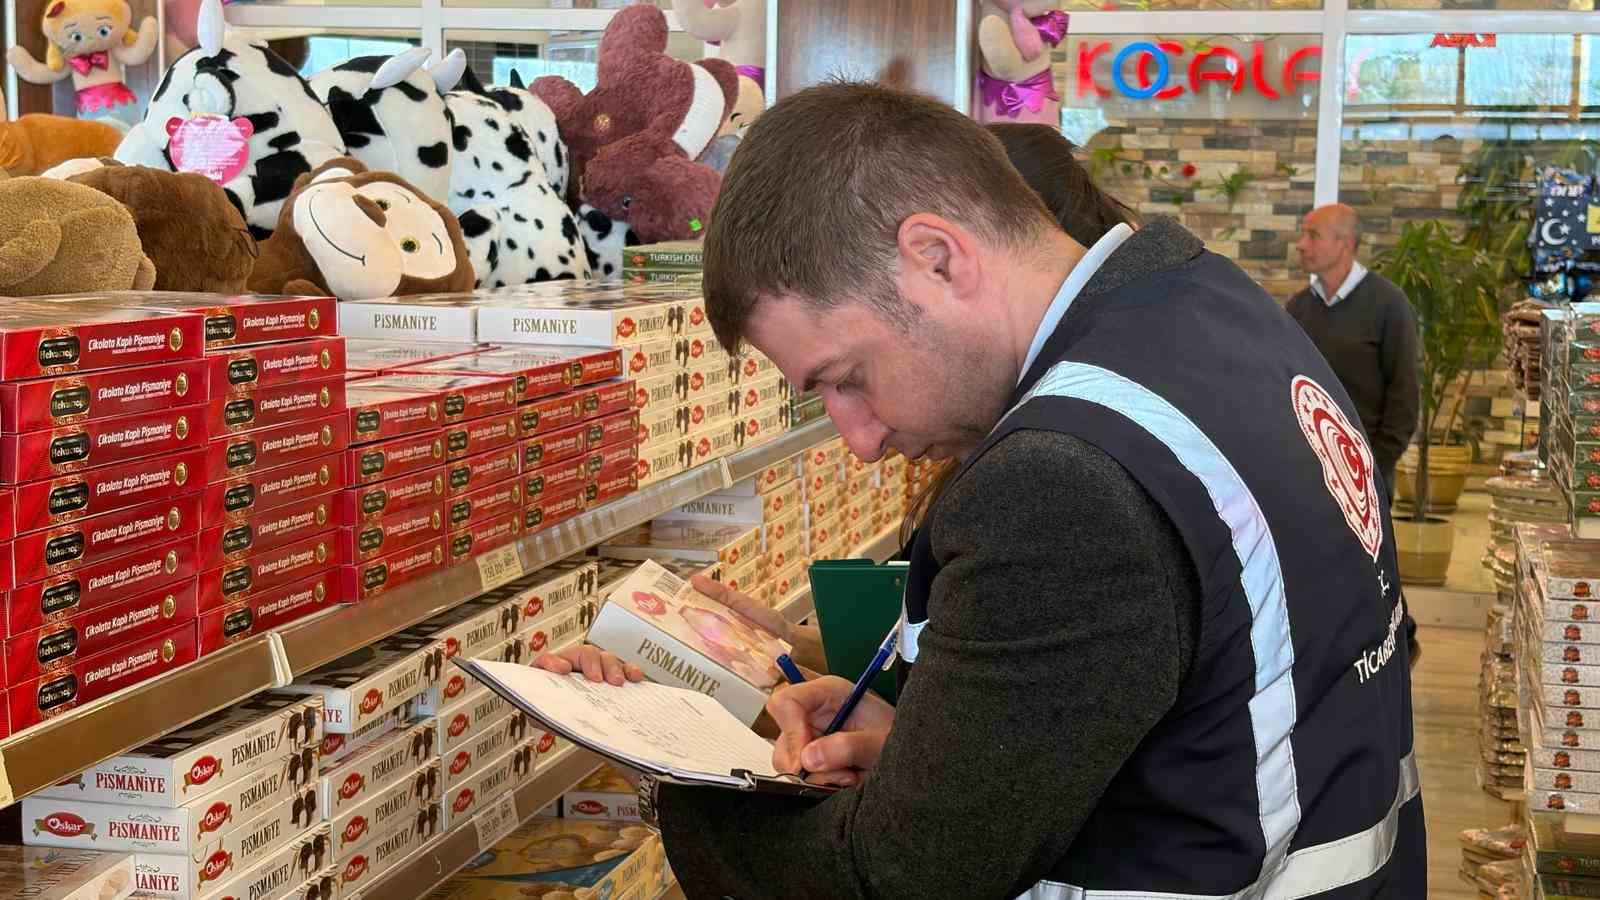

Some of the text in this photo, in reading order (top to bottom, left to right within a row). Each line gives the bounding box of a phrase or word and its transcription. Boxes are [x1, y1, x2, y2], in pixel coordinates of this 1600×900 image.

[89, 338, 115, 351] Çikolata
[135, 334, 165, 346] Pişmaniye
[98, 386, 124, 401] Çikolata
[141, 380, 172, 391] Pişmaniye
[98, 430, 124, 447] Çikolata
[141, 424, 172, 435] Pişmaniye
[97, 479, 122, 496] Çikolata
[140, 470, 170, 483] Pişmaniye
[92, 525, 118, 544] Çikolata
[135, 516, 164, 529] Pişmaniye
[88, 573, 114, 592] Çikolata
[131, 559, 161, 574] Pişmaniye
[85, 620, 111, 639] Çikolata
[128, 605, 159, 622] Pişmaniye
[85, 667, 110, 685] Çikolata
[128, 649, 158, 666] Pişmaniye
[192, 764, 216, 780] Oskar
[47, 817, 82, 832] Oskar
